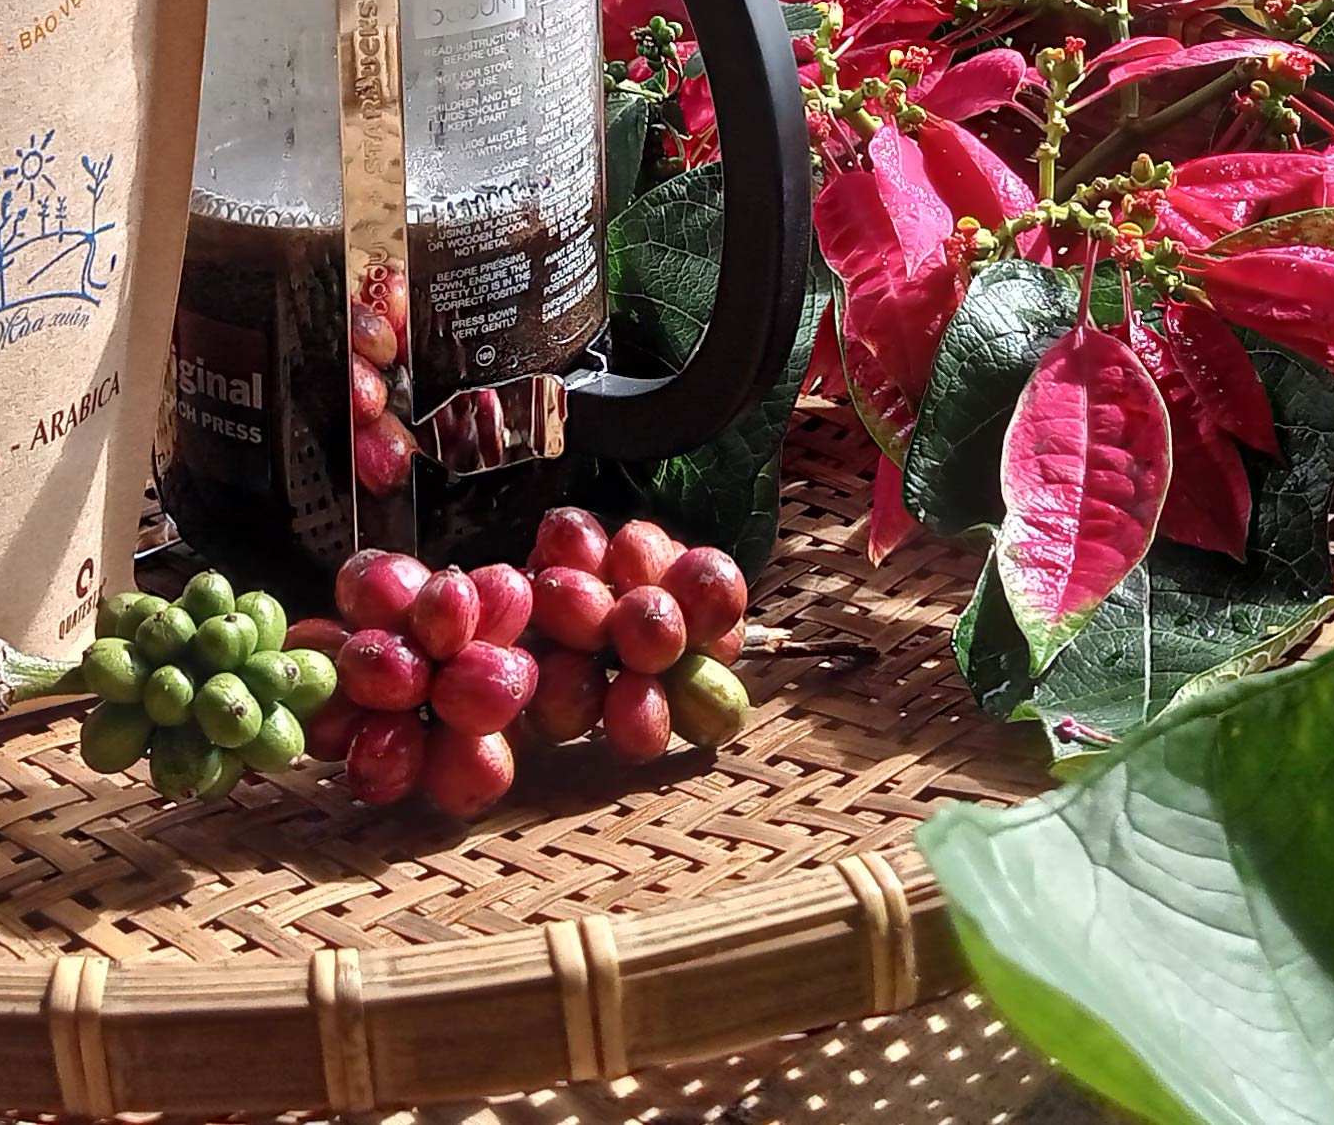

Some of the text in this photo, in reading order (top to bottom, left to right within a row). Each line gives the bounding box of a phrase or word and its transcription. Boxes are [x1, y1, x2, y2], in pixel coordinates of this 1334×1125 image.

[19, 13, 58, 51] BẢO
[455, 30, 520, 54] INSTRUCTION
[443, 43, 507, 66] BEFORE USE
[436, 59, 515, 85] NOT FOR STOVE
[455, 74, 499, 91] TOP USE
[426, 84, 523, 115] CHILDREN AND HOT
[428, 95, 522, 124] FLUIDS SHOULD BE
[447, 111, 507, 132] KEPT APART
[477, 135, 528, 157] WITH CARE
[487, 129, 515, 145] MUST
[516, 125, 528, 136] BE
[492, 157, 530, 174] COARSE
[438, 211, 523, 240] USING A PLASTIC
[428, 240, 444, 251] OR
[447, 230, 493, 248] WOODEN
[454, 237, 510, 258] NOT METAL
[430, 259, 532, 293] DOWN, ENSURE THAT
[437, 251, 526, 282] BEFORE PRESSING
[430, 270, 531, 303] SAFETY LID IS IN THE
[435, 282, 529, 313] CORRECT POSITION
[451, 306, 517, 330] PRESS DOWN
[452, 315, 518, 340] VERY GENTLY
[170, 343, 262, 410] iginal
[29, 371, 121, 451] ARABICA
[201, 412, 263, 443] PRESS
